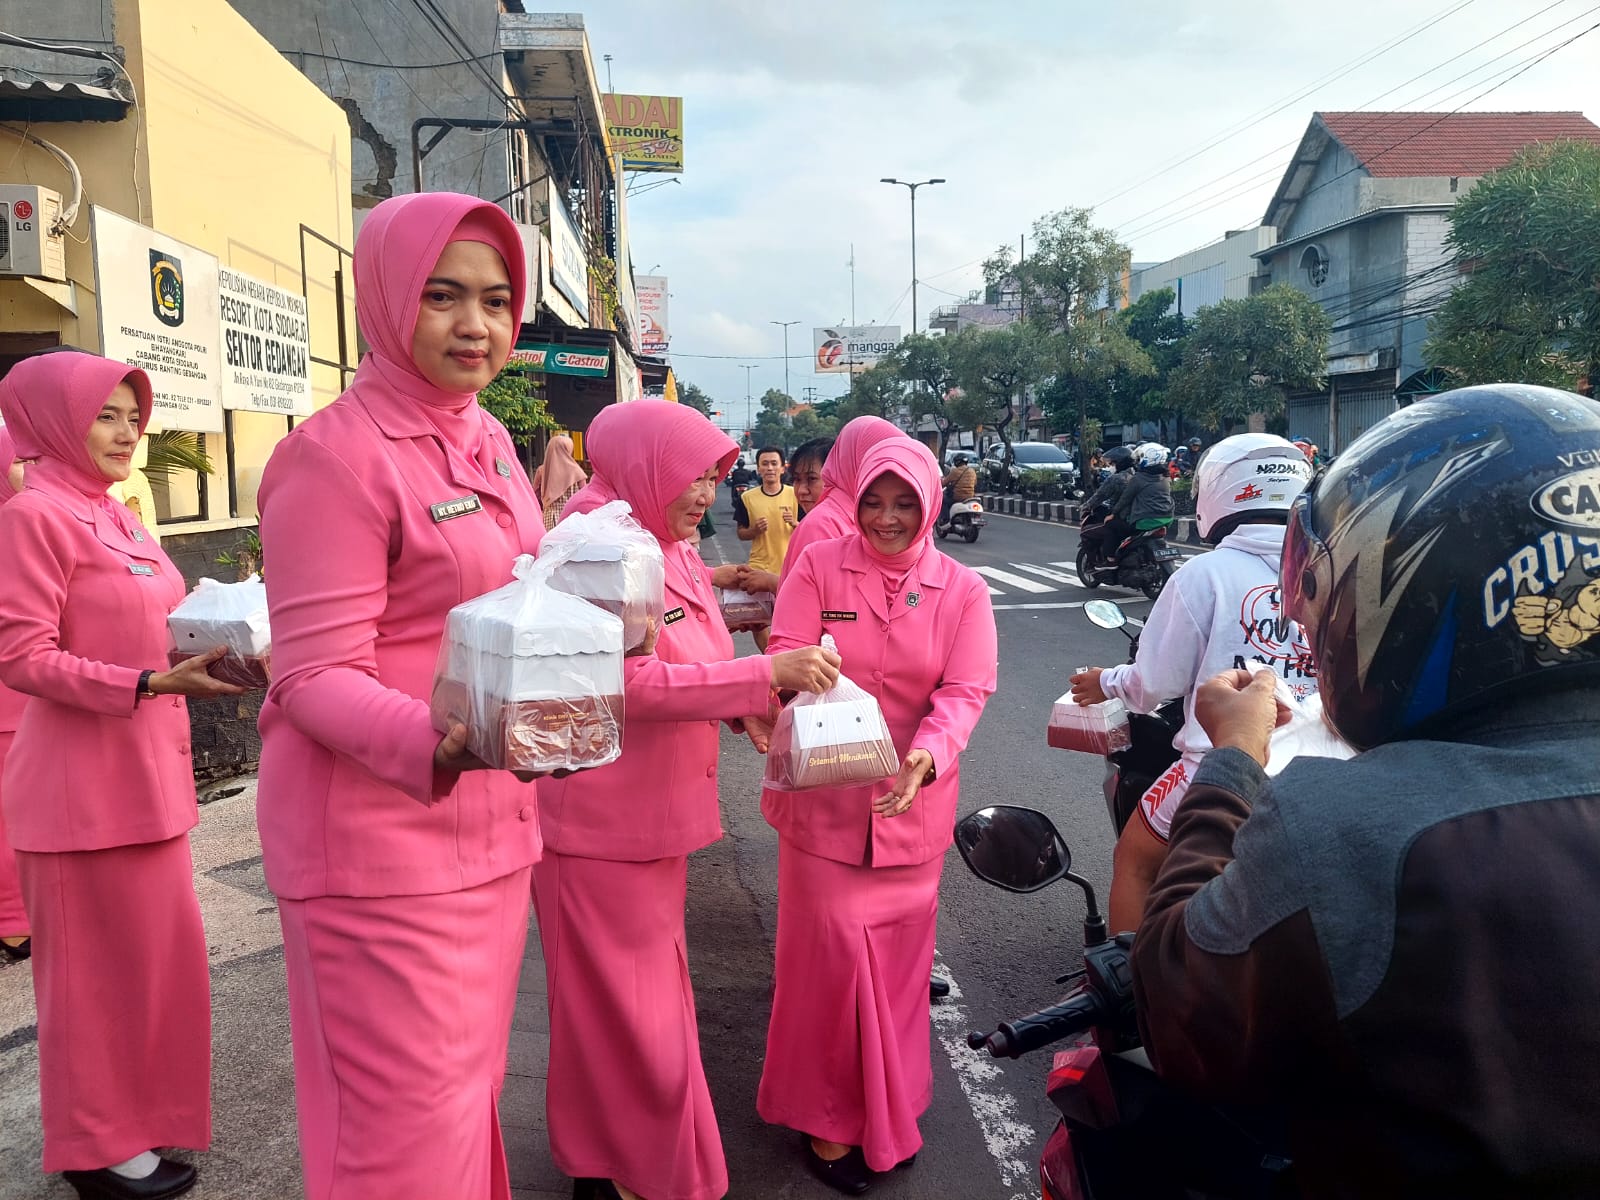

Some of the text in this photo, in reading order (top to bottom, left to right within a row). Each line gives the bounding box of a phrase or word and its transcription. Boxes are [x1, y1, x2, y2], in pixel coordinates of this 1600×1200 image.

[603, 94, 677, 129] ADAI
[16, 222, 31, 231] LG
[220, 294, 307, 343] RESORT KOTA SIDOARJO
[120, 326, 208, 354] PERSATUAN ISTRI ANGGOTA POLRI
[226, 328, 307, 379] SEKTOR GEDANGAN
[848, 342, 895, 354] mangga
[126, 358, 207, 380] PENGURUS RANTING GEDANGAN
[135, 350, 199, 370] CABANG KOTA SIDOARJO
[567, 354, 604, 367] Castrol
[1551, 484, 1600, 516] CA
[1484, 530, 1600, 628] CRUS
